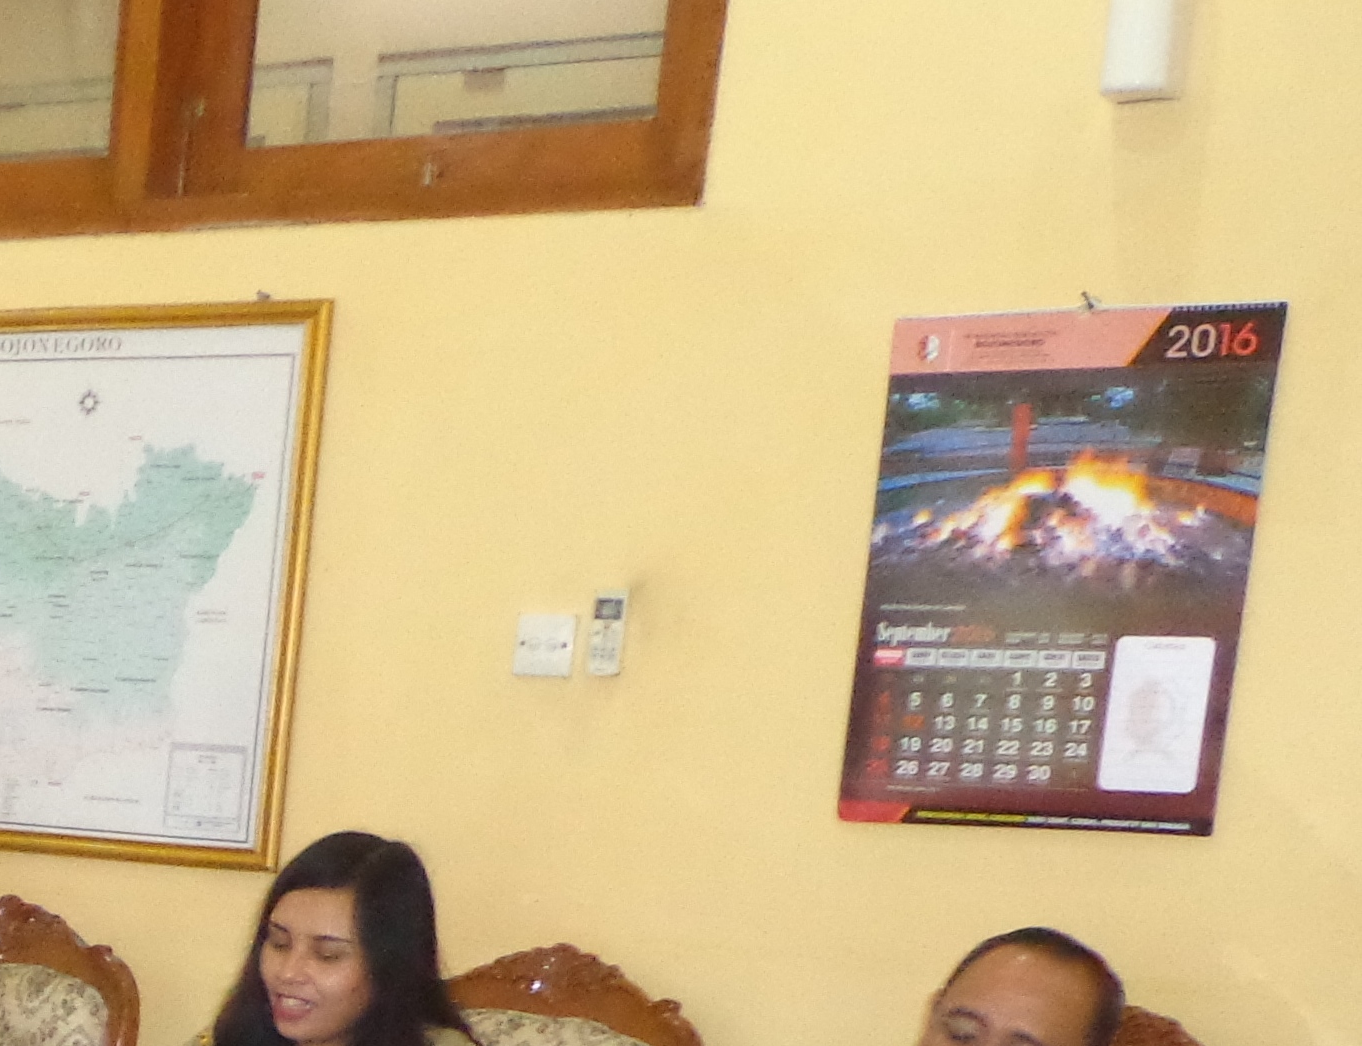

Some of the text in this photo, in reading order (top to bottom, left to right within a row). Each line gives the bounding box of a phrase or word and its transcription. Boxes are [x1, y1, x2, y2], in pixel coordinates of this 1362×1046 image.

[1164, 322, 1260, 360] 2016
[877, 621, 952, 646] September
[1012, 672, 1092, 687] 1 2 3
[910, 692, 922, 706] 5
[942, 693, 954, 707] 6
[975, 694, 987, 708] 7
[1042, 695, 1054, 710] 9
[1073, 696, 1094, 711] 10
[934, 716, 956, 730] 13
[967, 717, 989, 731] 14
[1001, 718, 1023, 732] 15
[1034, 719, 1057, 733] 16
[1070, 720, 1092, 734] 17
[930, 738, 953, 752] 20
[962, 739, 984, 753] 21
[997, 740, 1020, 755] 22
[1030, 741, 1053, 756] 23
[1064, 743, 1088, 757] 24
[896, 760, 919, 775] 26
[927, 762, 950, 776] 27
[960, 763, 983, 778] 28
[993, 764, 1017, 779] 29
[1027, 765, 1051, 780] 30
